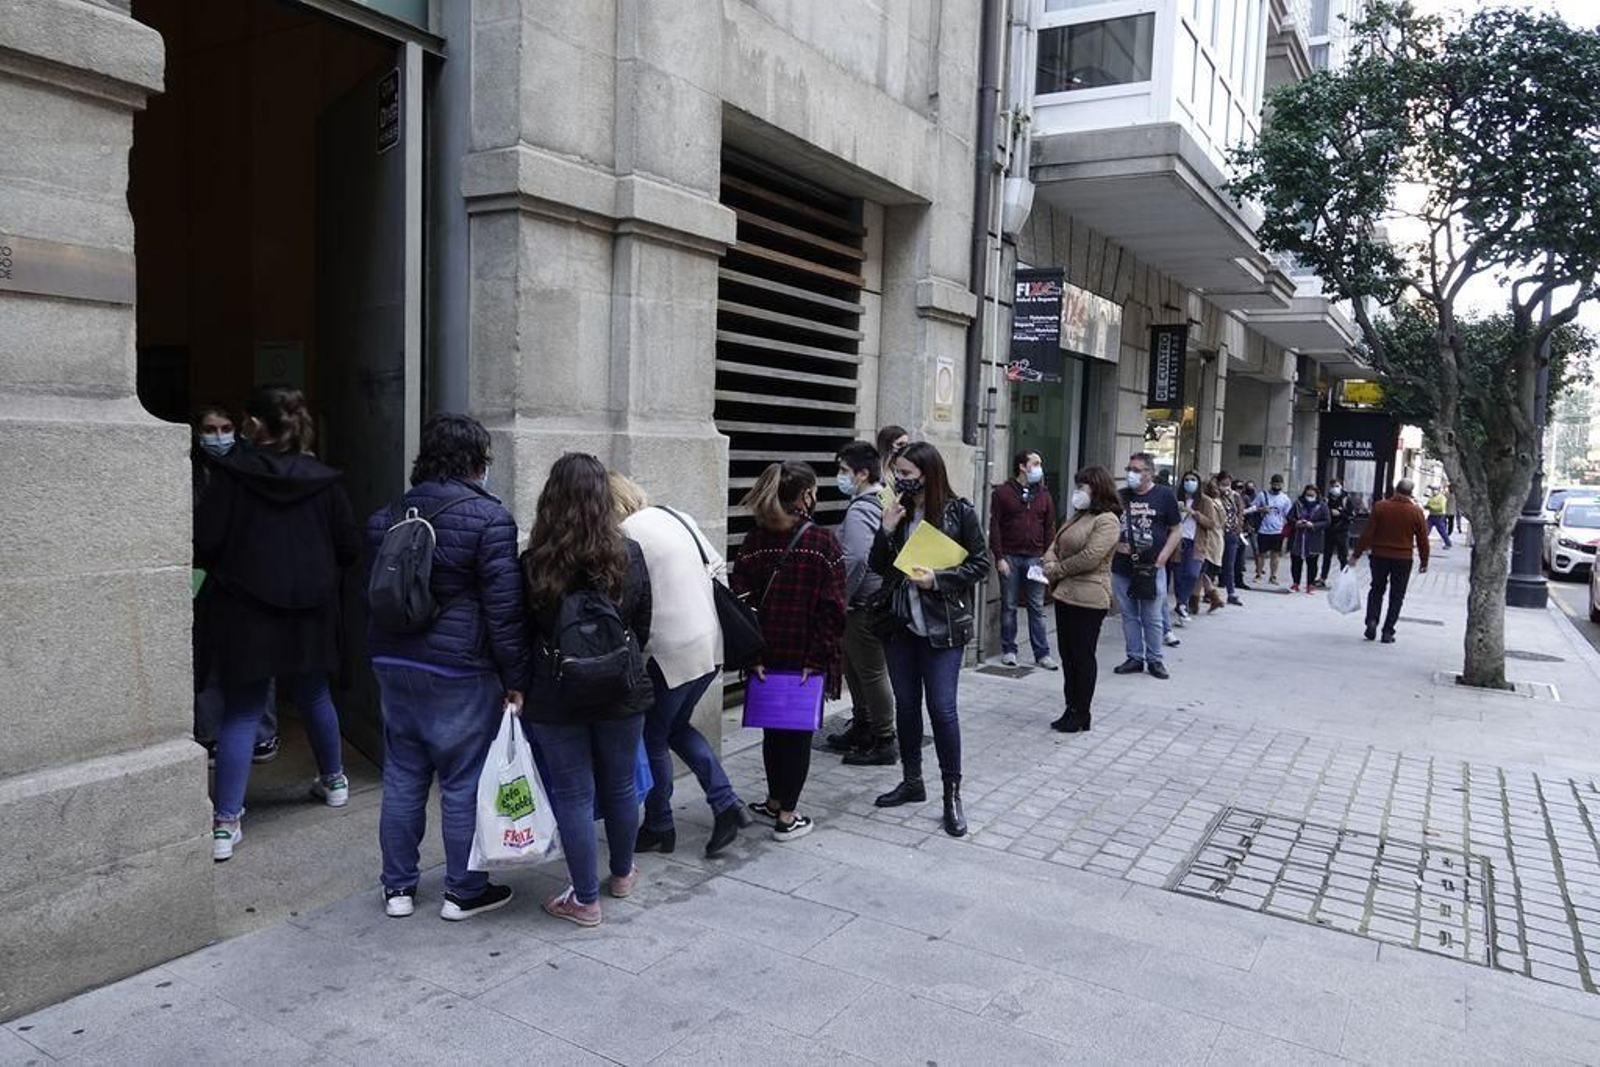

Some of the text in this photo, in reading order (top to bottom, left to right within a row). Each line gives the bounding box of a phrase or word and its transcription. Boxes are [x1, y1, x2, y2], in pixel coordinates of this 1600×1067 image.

[1157, 335, 1169, 399] DE CUATRO
[1333, 439, 1373, 449] CAFÉ BAR
[1343, 449, 1375, 457] ILUSIÓN
